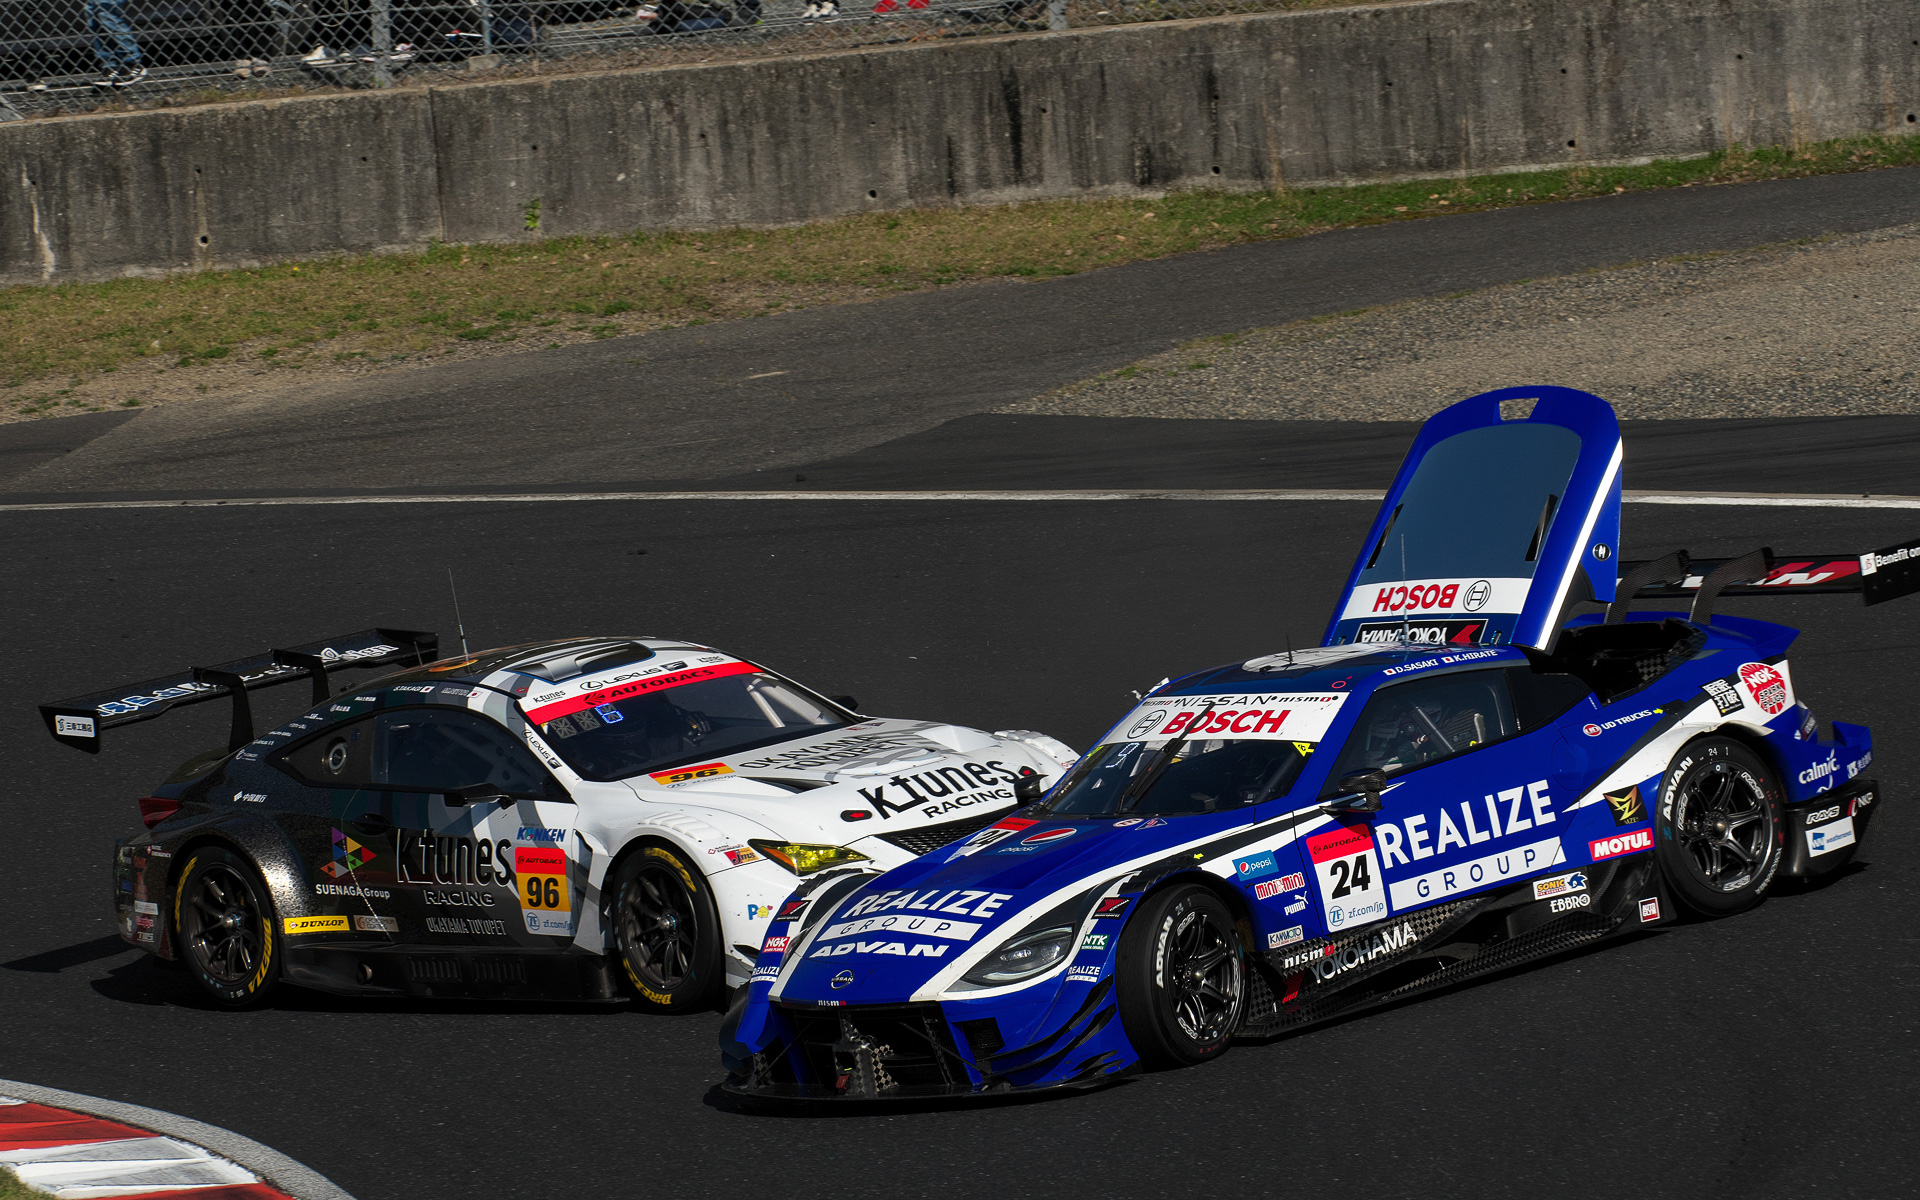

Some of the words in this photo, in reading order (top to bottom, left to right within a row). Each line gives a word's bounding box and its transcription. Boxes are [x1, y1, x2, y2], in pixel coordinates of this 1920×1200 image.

[1875, 548, 1909, 567] Benefit
[1372, 584, 1460, 612] BOSCH
[1395, 659, 1439, 673] D.SASAKI
[1454, 650, 1498, 662] K.HIRATE
[603, 667, 662, 685] LEXUS
[611, 669, 714, 697] AUTOBACS
[1745, 667, 1776, 688] NGK
[1175, 696, 1272, 707] NISSAN
[1758, 682, 1782, 701] SPARK
[1762, 691, 1785, 710] PLUGS
[1159, 709, 1292, 735] BOSCH
[1601, 721, 1617, 730] UD
[1614, 709, 1653, 725] TRUCKS
[739, 735, 875, 769] OKAYAMA
[775, 741, 908, 770] TOYOPET
[669, 768, 719, 783] 96
[1798, 756, 1837, 784] calmic
[1663, 756, 1693, 821] ADVAN
[922, 788, 1014, 818] RACING
[1375, 779, 1557, 870] REALIZE
[1806, 805, 1840, 825] RAYS
[1322, 834, 1368, 851] AUTOBACS
[1594, 831, 1651, 858] MOTUL
[524, 857, 563, 865] AUTOBACS
[1250, 857, 1272, 872] pepsi
[1330, 854, 1371, 900] 24
[1417, 848, 1536, 898] GROUP
[315, 883, 363, 897] SUENAGA
[363, 887, 391, 899] Group
[526, 876, 560, 908] 96
[1537, 880, 1565, 892] SONIC
[423, 889, 495, 906] RACING
[841, 890, 1013, 919] REALIZE
[1284, 901, 1306, 916] PUMA
[1348, 902, 1384, 918] zf.com/jp
[300, 918, 345, 928] DUNLOP
[840, 916, 953, 934] GROUP
[765, 936, 788, 948] NGK
[809, 942, 949, 957] ADVAN
[1082, 935, 1108, 946] NTK
[1156, 915, 1174, 989] ADVAN
[1284, 944, 1335, 969] nismo
[1310, 921, 1418, 984] YOKOHAMA
[1067, 966, 1101, 976] REALIZE
